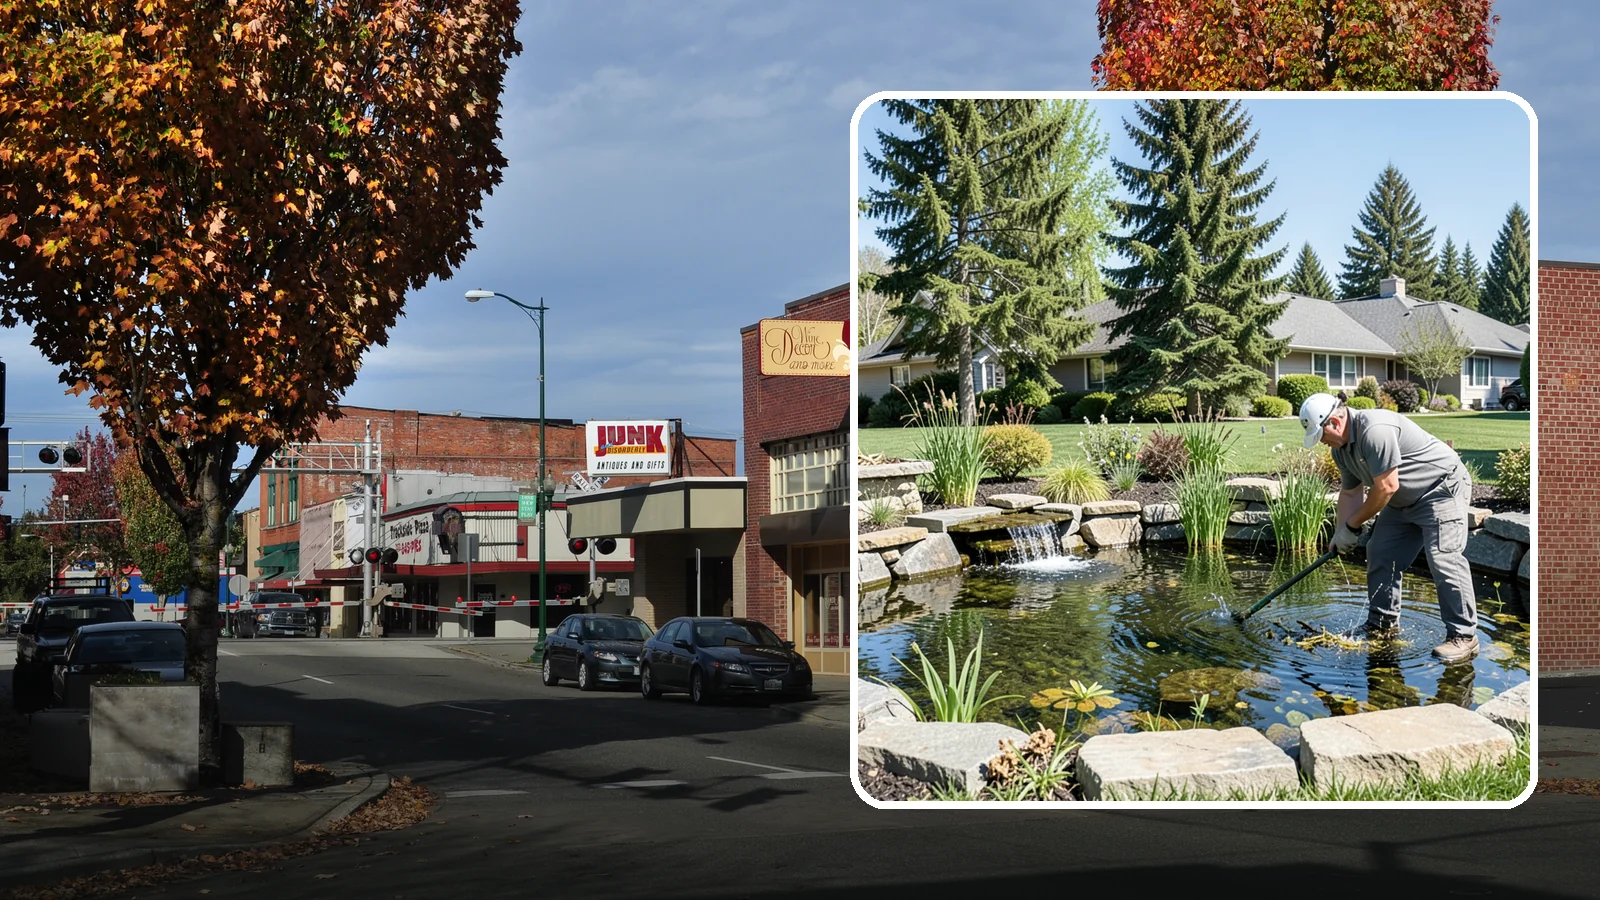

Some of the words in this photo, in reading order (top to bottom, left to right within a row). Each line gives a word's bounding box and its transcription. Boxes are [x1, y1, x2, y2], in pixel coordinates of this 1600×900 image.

[764, 328, 831, 365] Decor
[595, 425, 665, 457] JUNK
[608, 446, 646, 454] DISORDERLY
[597, 461, 628, 470] ANTIQUES
[631, 461, 644, 469] AND
[647, 460, 665, 469] GIFTS
[390, 522, 412, 540] Trackside
[414, 519, 429, 535] Pizza
